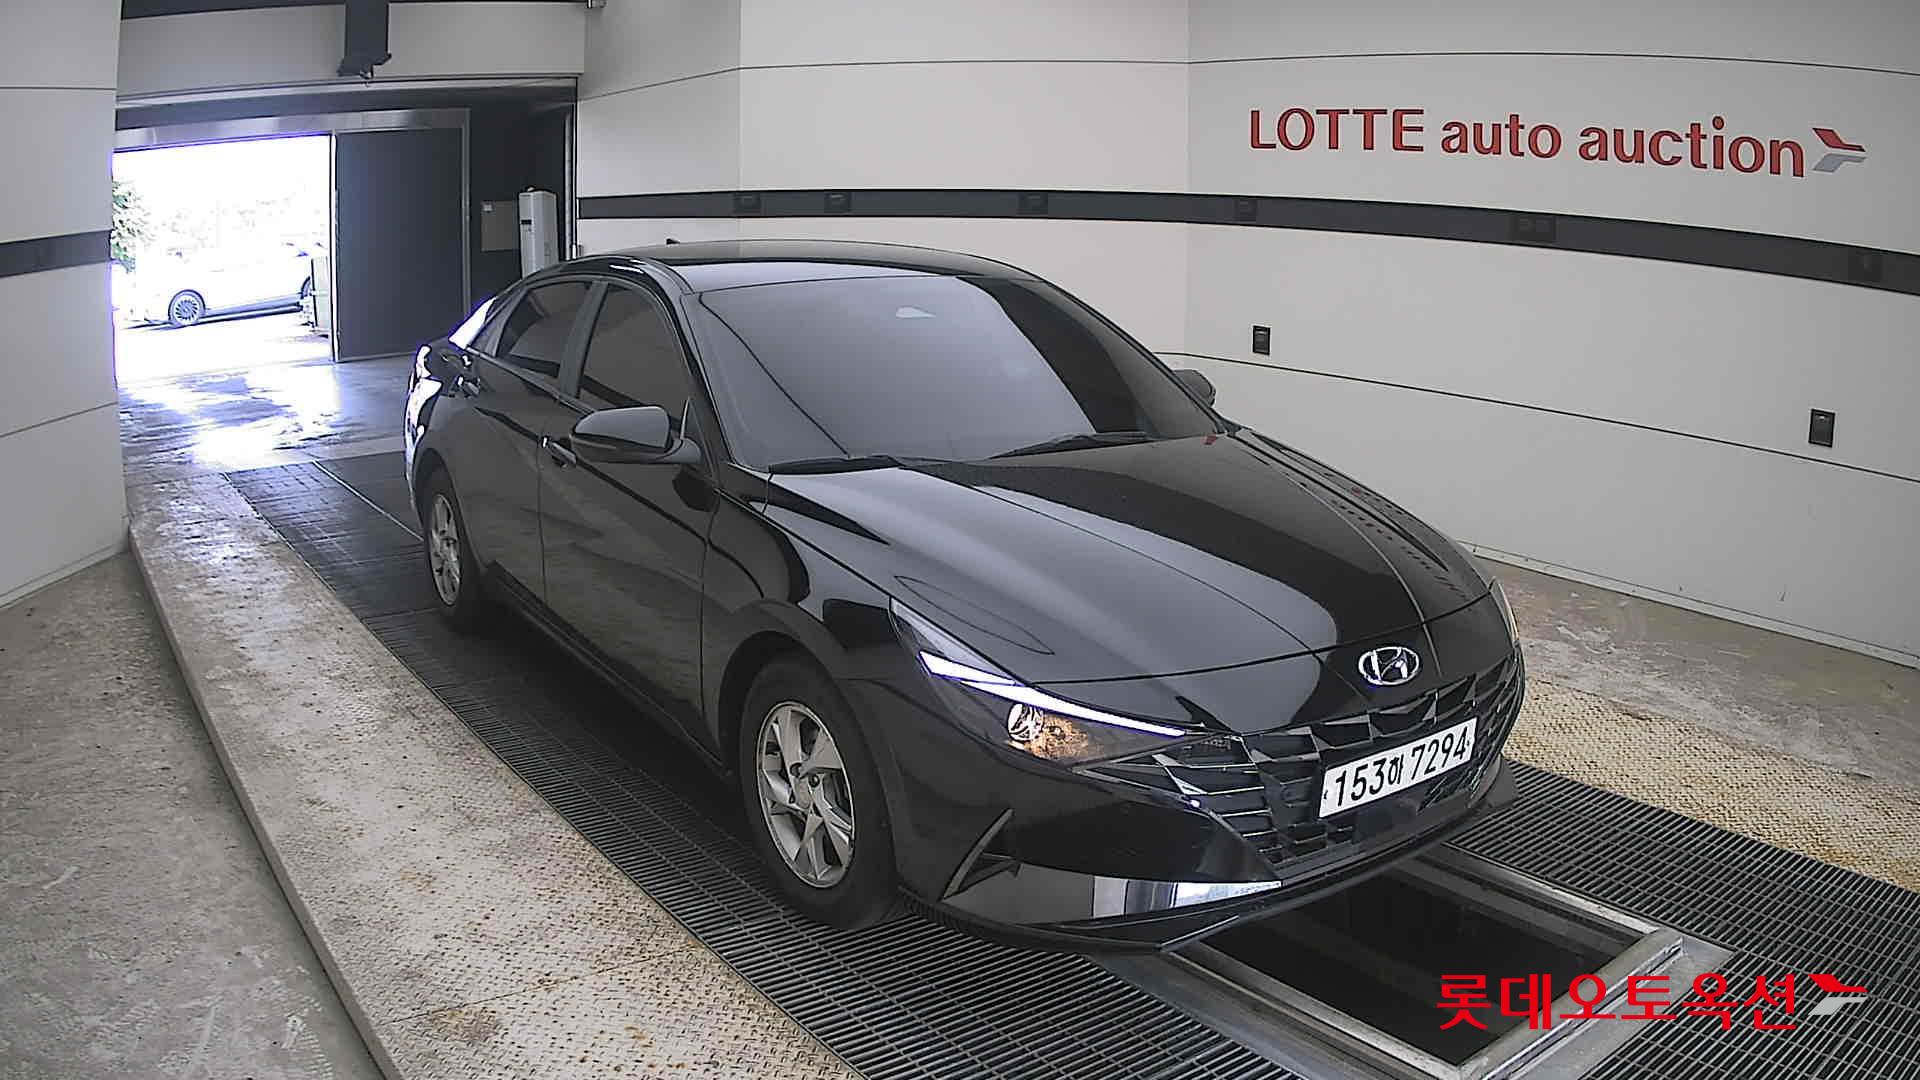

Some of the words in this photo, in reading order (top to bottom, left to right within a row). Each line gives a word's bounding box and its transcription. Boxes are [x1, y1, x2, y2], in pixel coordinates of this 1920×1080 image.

[1249, 107, 1425, 153] LOTTE
[1440, 113, 1563, 159] auto
[1577, 115, 1806, 178] auction
[1335, 753, 1404, 807] 153하
[1411, 726, 1469, 780] 7294
